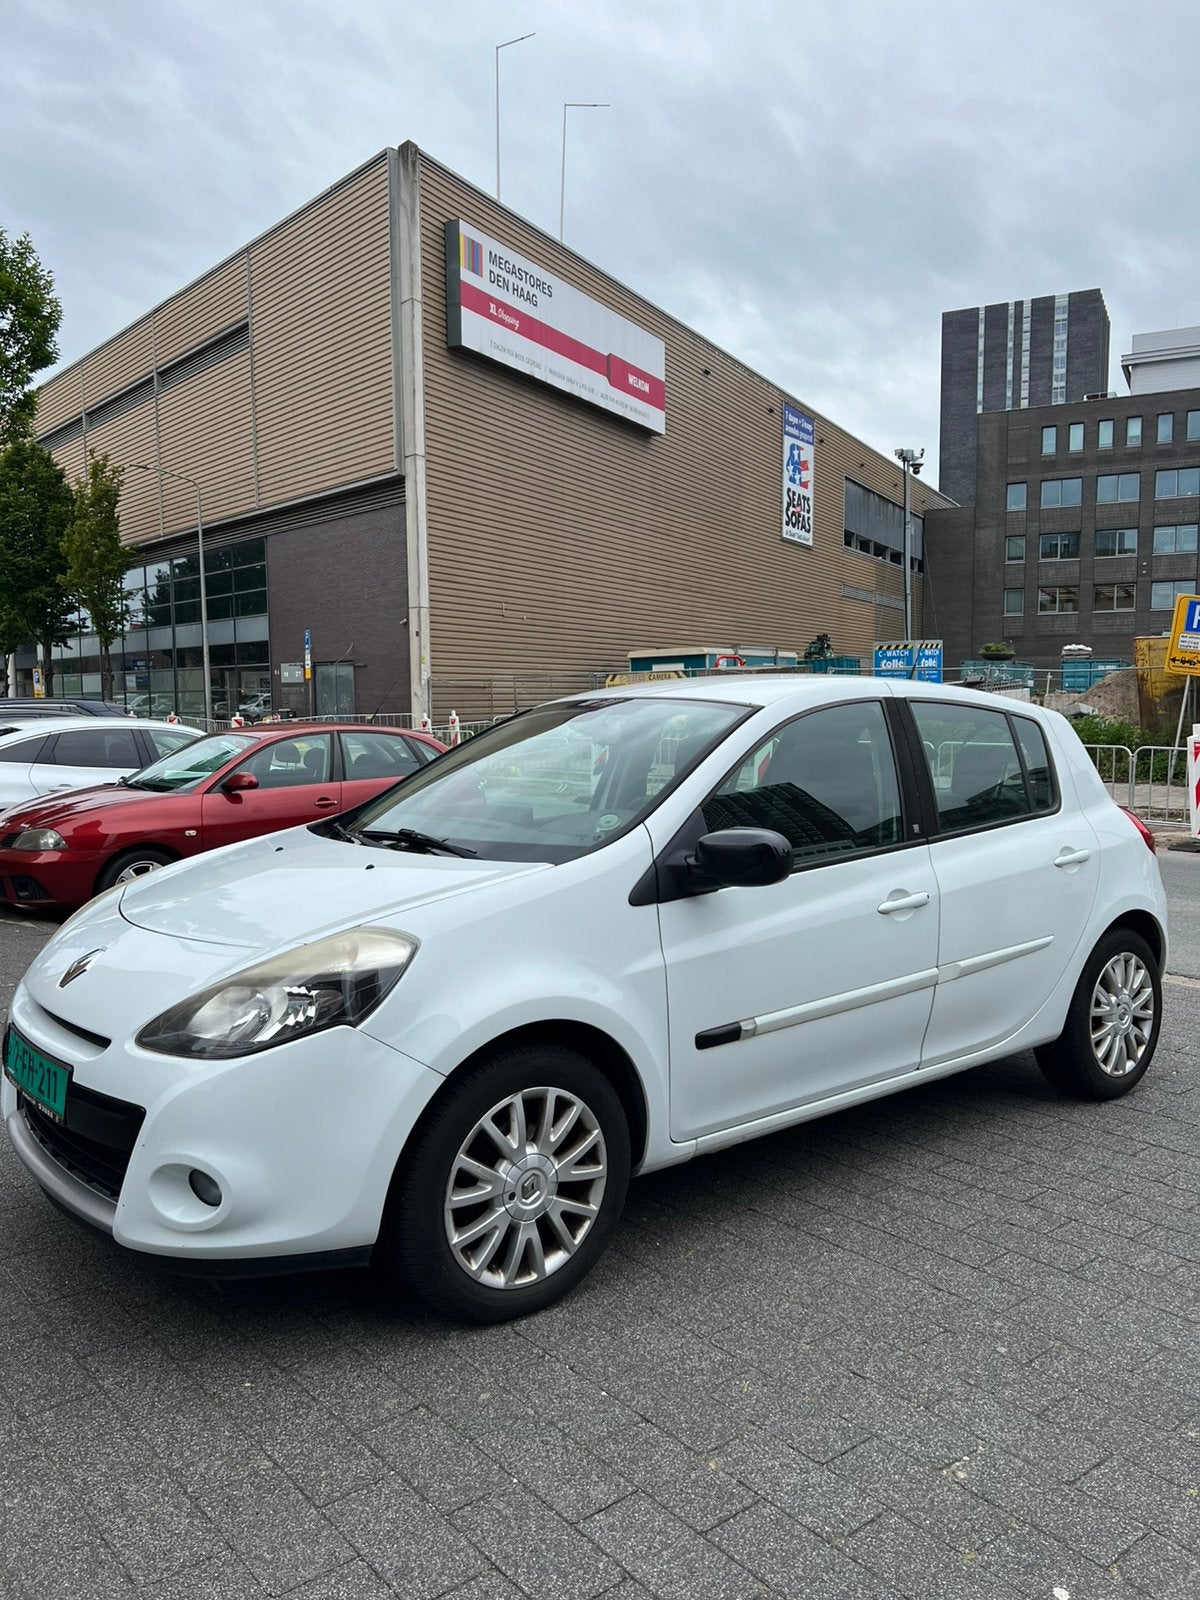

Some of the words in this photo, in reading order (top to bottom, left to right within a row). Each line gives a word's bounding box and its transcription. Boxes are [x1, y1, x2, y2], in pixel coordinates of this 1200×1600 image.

[488, 250, 553, 298] MEGASTORES
[488, 269, 510, 292] DEN
[512, 281, 538, 307] HAAG
[489, 302, 498, 316] XL
[497, 307, 520, 331] Shopping
[628, 373, 650, 394] WELKOM
[786, 487, 811, 515] SEATS
[785, 501, 811, 534] SOFAS
